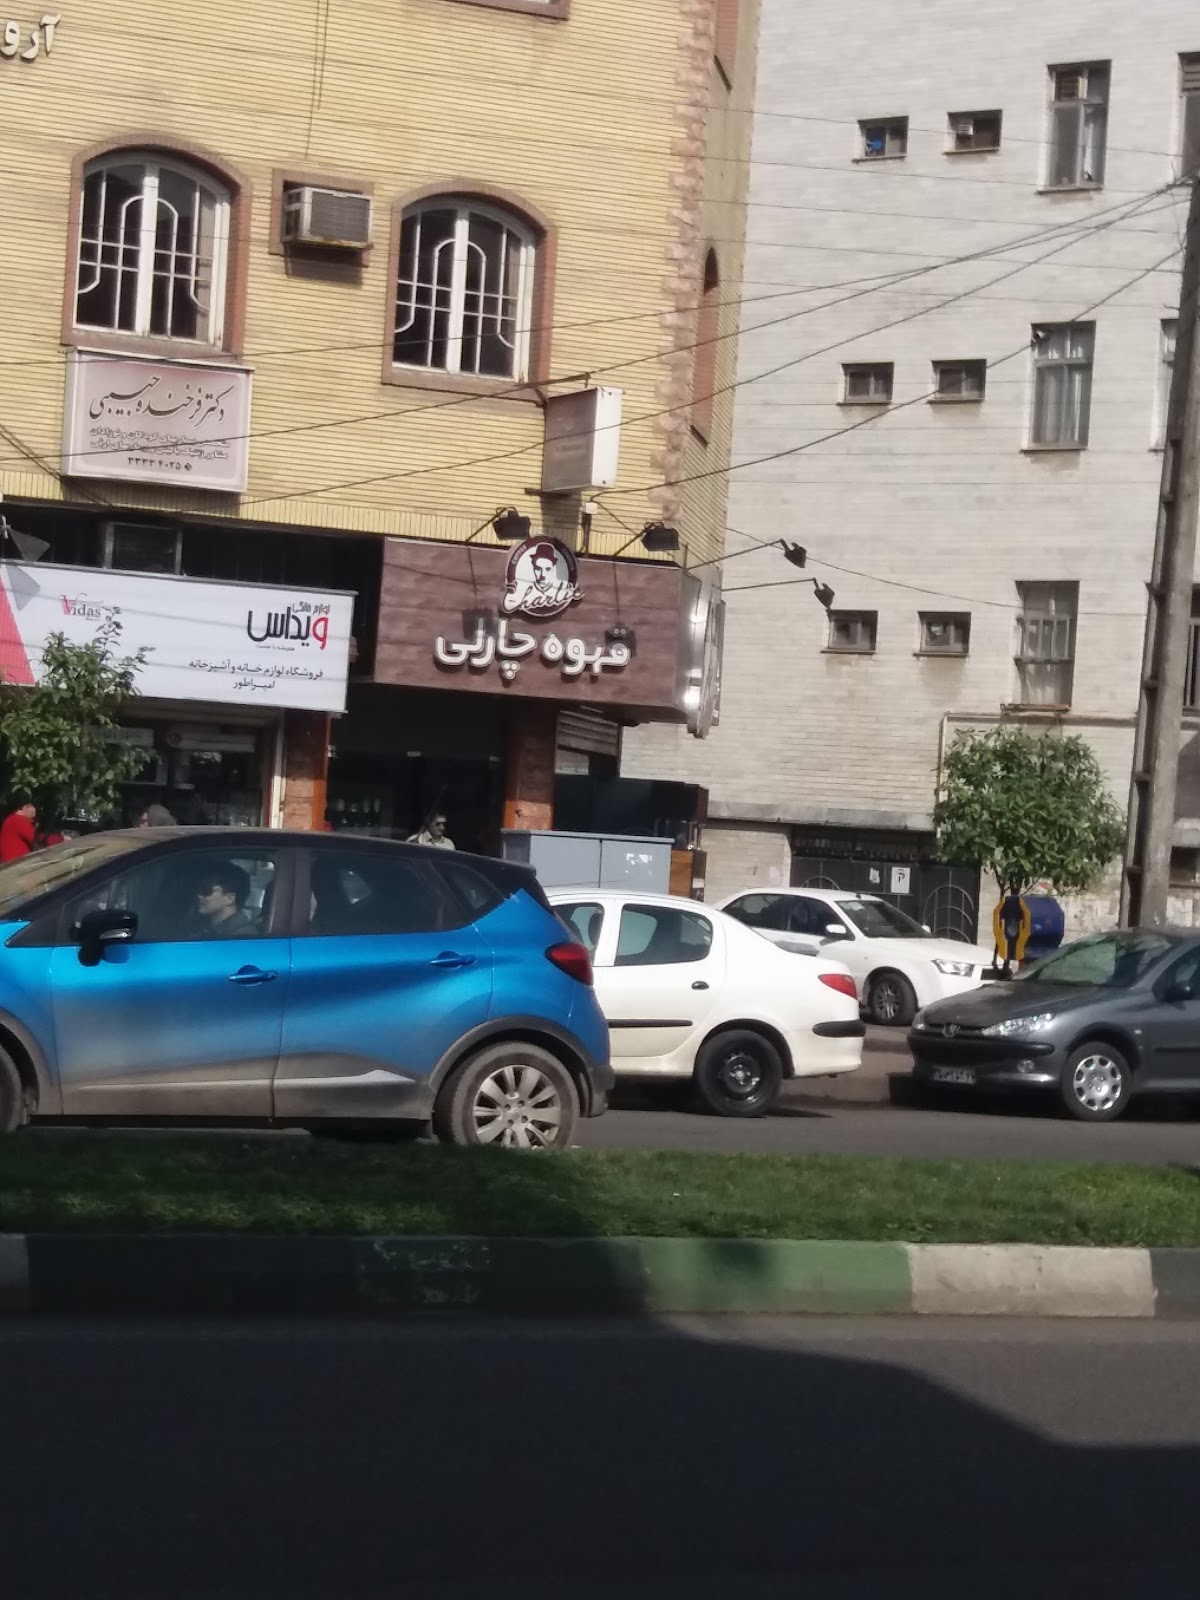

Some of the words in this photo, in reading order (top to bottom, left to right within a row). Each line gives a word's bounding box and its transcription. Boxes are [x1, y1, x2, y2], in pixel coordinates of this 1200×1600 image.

[89, 376, 161, 419] حبیبی
[135, 383, 203, 420] فرخنده
[194, 386, 235, 427] دکتر
[60, 593, 102, 616] Vidas
[502, 580, 586, 613] Charlie
[247, 606, 329, 651] ویداس
[435, 616, 537, 681] چارلی
[543, 627, 631, 676] قهوه
[236, 662, 262, 673] خانه
[264, 665, 284, 677] لوازم
[286, 666, 323, 680] فروشگاه
